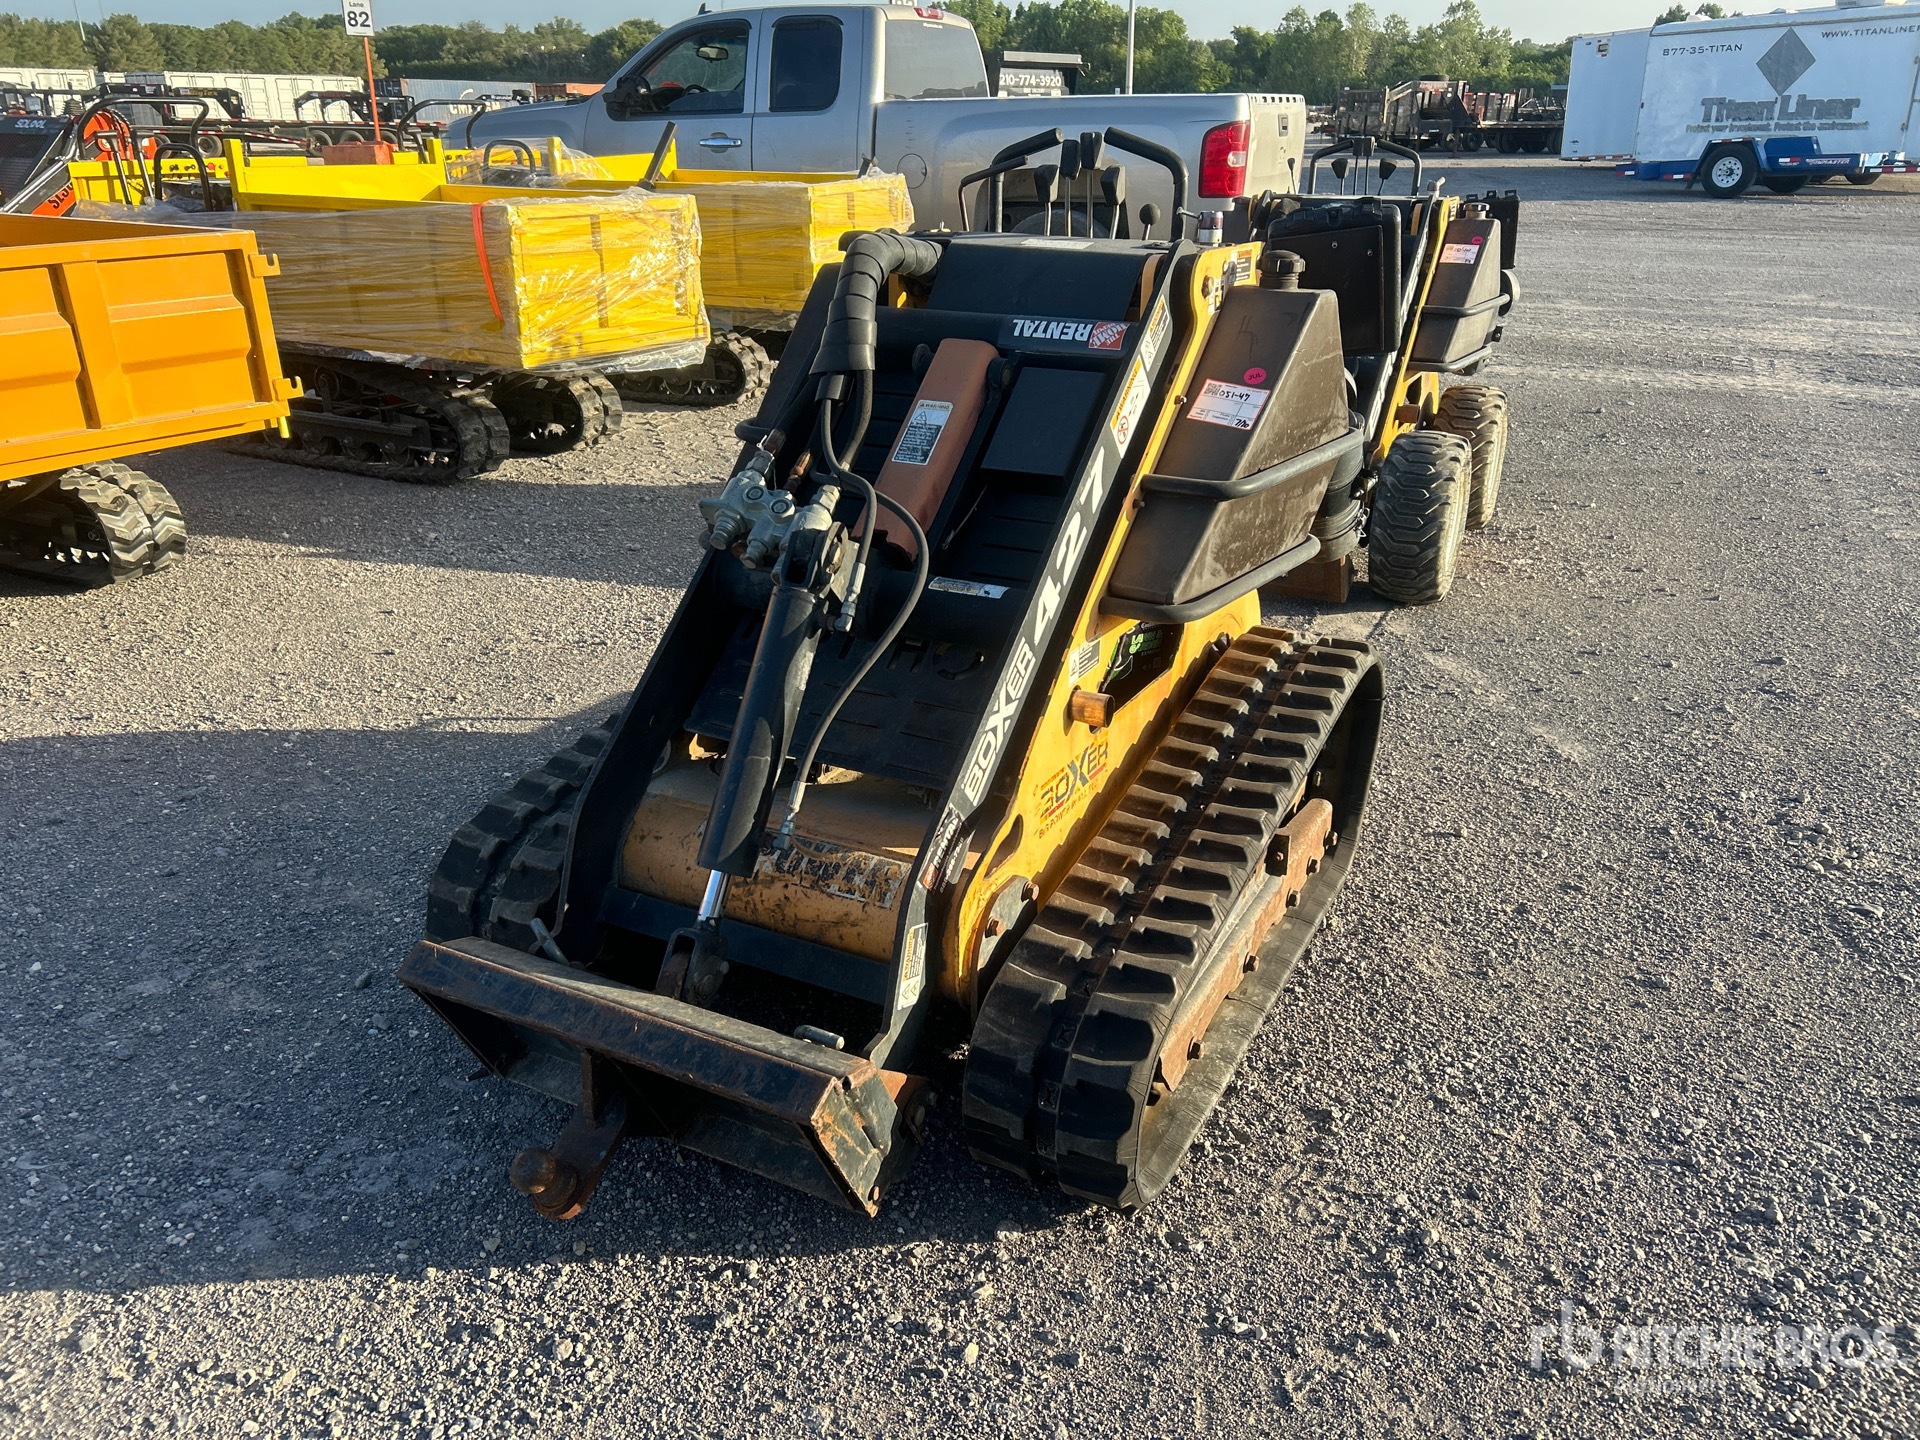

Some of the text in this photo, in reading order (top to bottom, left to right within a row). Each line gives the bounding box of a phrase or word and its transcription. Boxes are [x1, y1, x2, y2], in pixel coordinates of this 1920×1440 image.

[347, 10, 371, 28] 82
[1662, 43, 1743, 56] 877-35-TITAN
[999, 73, 1062, 87] 210-774-3920
[1701, 94, 1861, 122] Titan Liner
[1013, 319, 1094, 341] RENTAL
[962, 446, 1105, 807] BOXER 427
